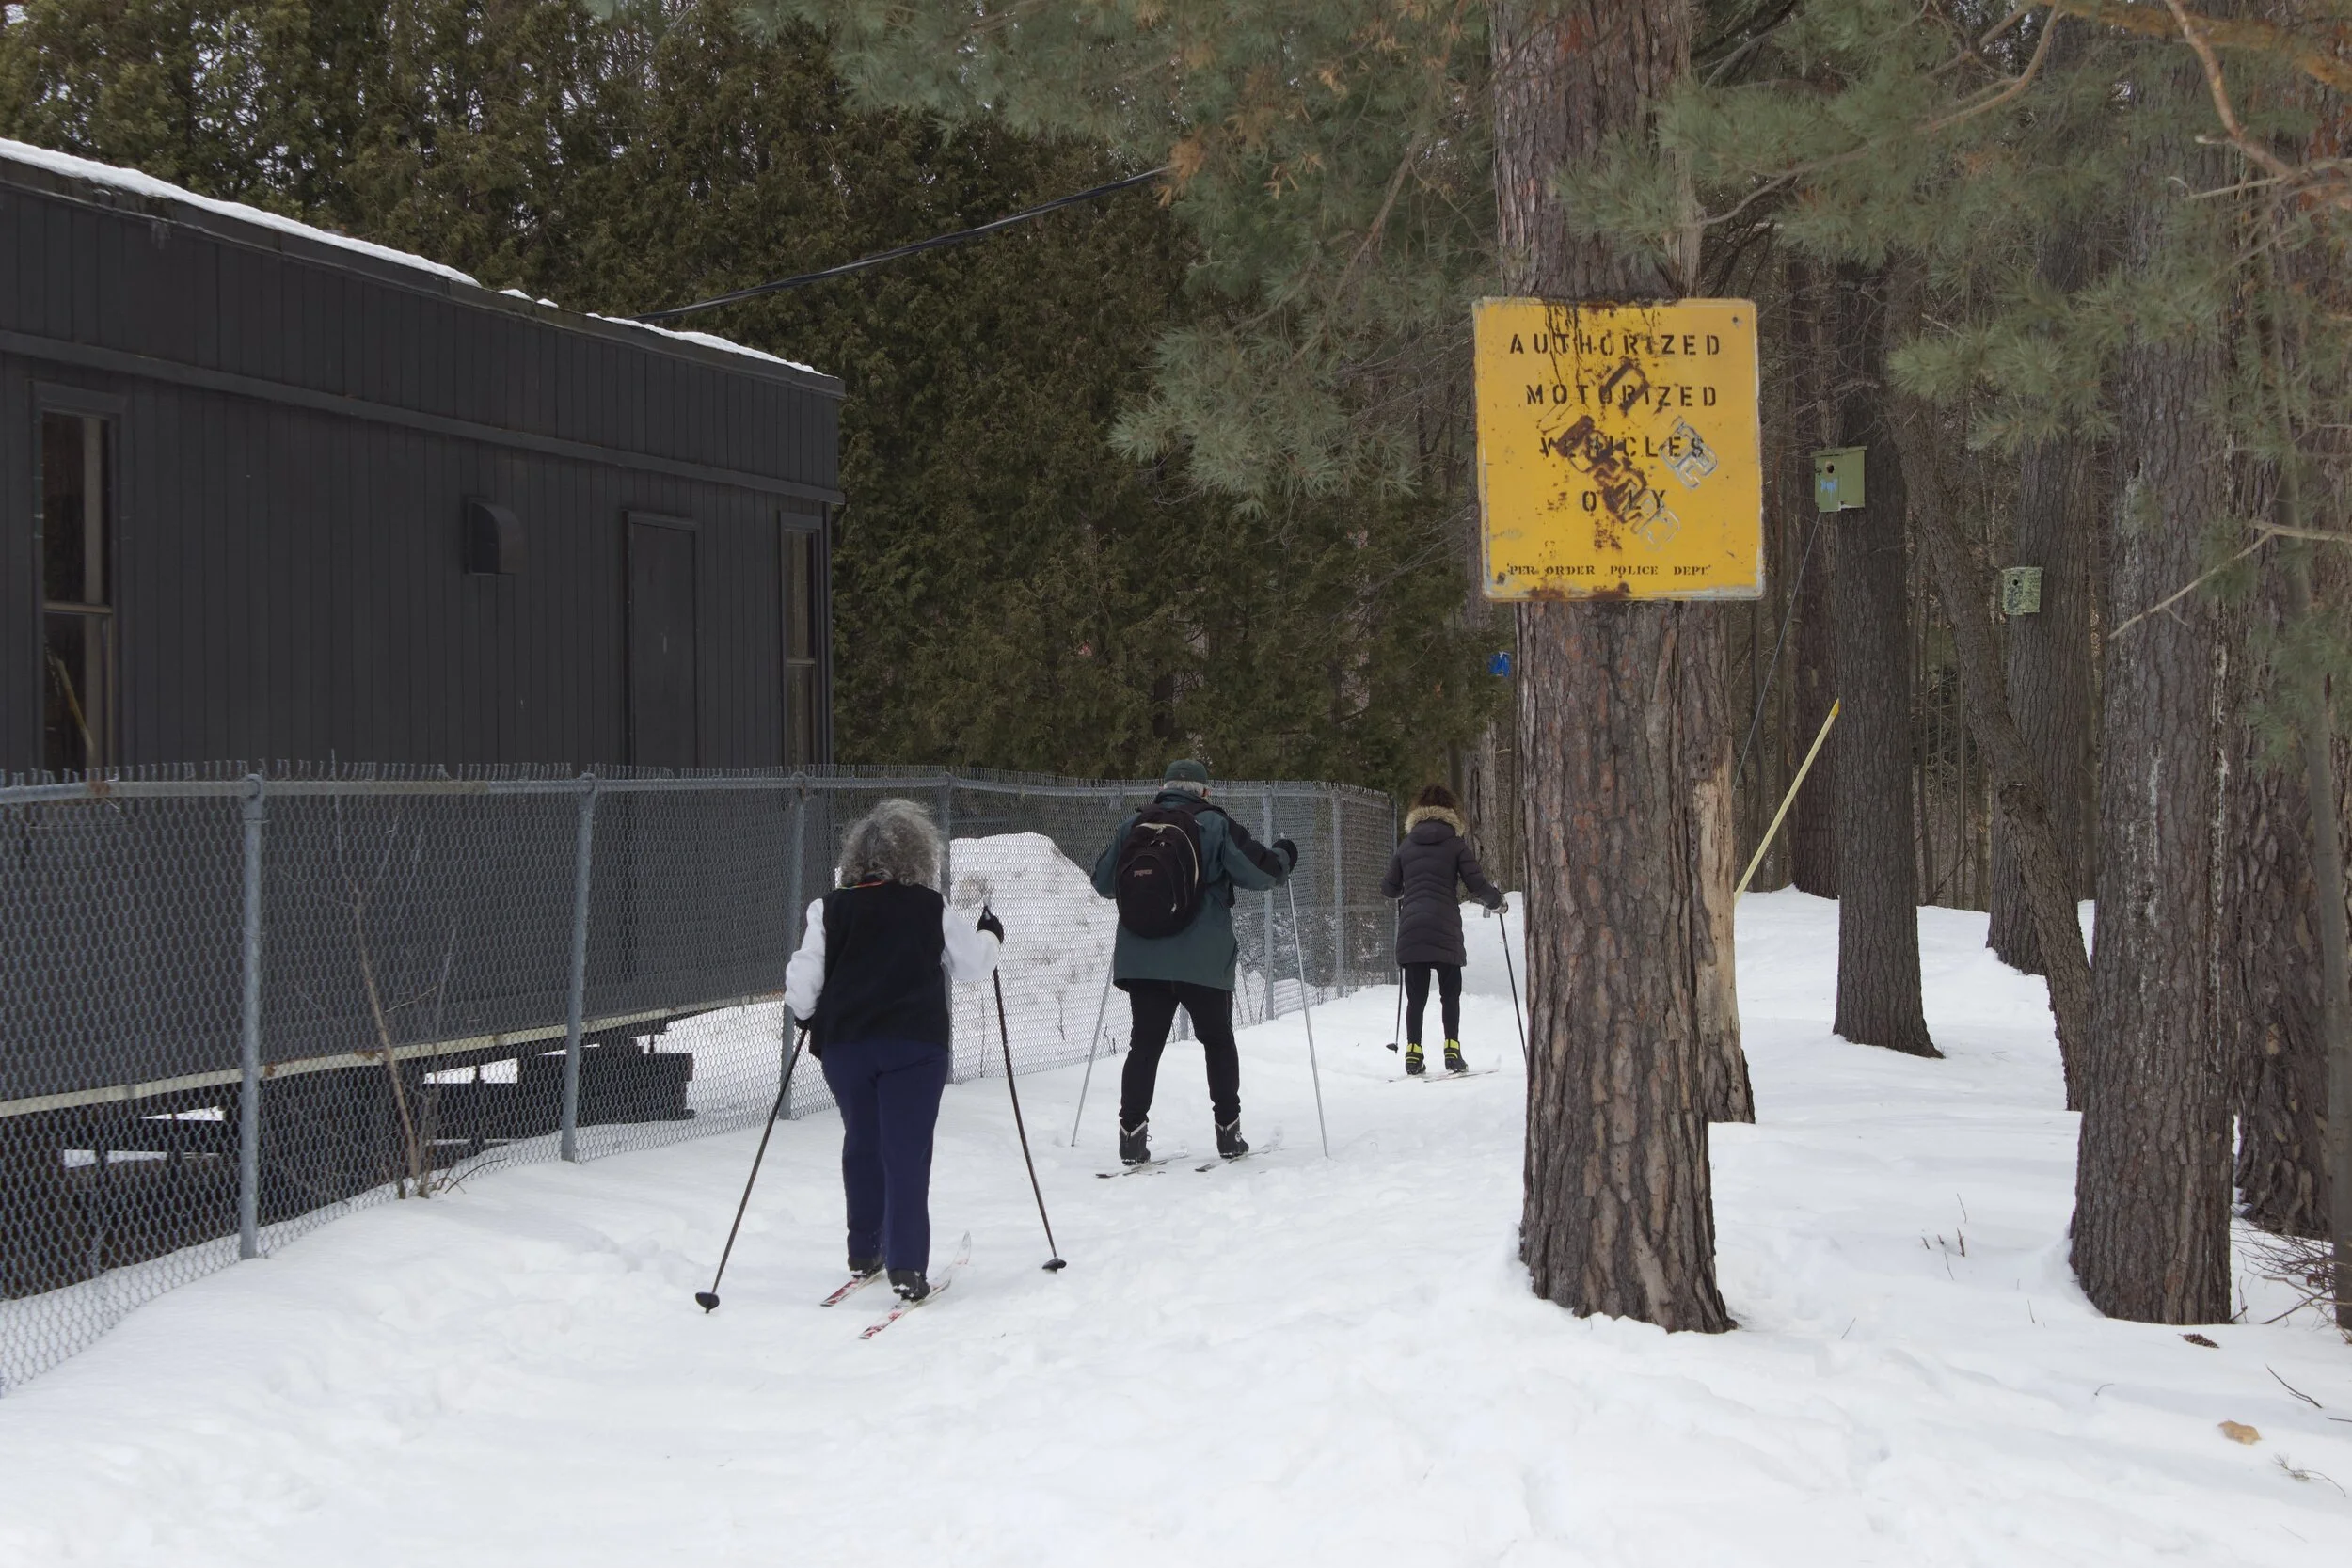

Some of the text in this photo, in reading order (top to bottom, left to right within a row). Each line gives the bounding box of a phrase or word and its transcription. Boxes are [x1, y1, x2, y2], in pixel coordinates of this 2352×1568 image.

[1510, 333, 1720, 356] AUTHORIZED
[1526, 384, 1716, 407] MOTORIZED
[1582, 489, 1665, 512] OLY
[1509, 565, 1534, 576] PER
[1544, 565, 1595, 576] ORDER
[1610, 565, 1658, 576] POLICE
